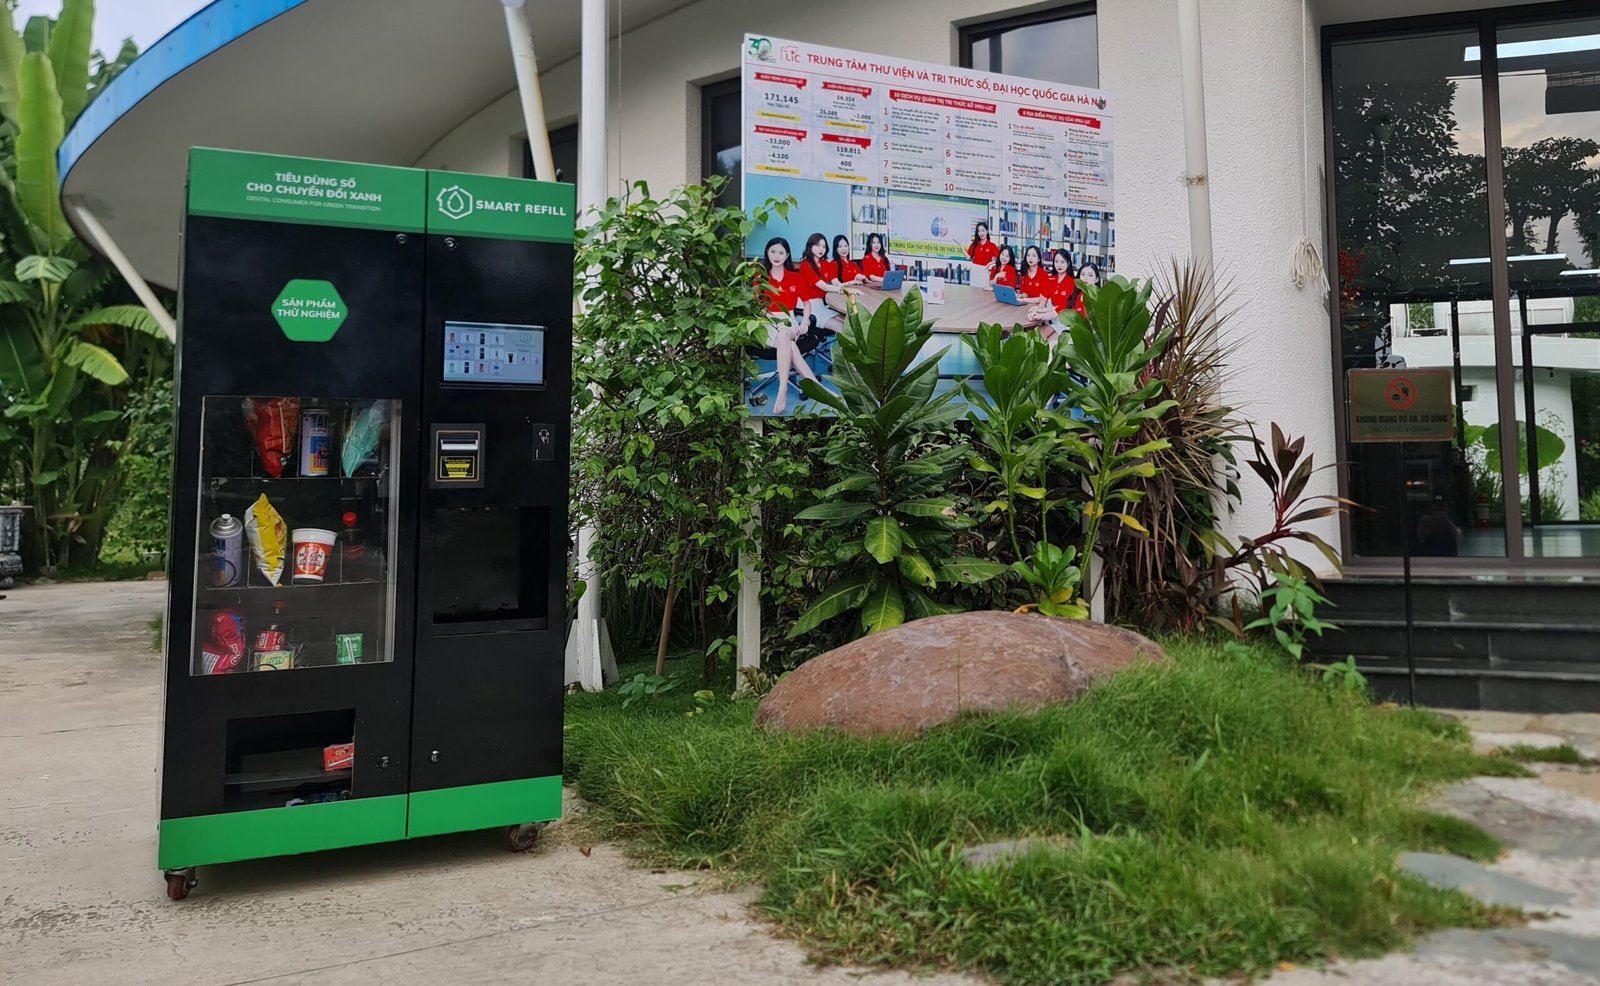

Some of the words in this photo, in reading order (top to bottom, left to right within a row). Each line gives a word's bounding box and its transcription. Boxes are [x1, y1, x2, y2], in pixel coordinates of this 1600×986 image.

[807, 54, 842, 68] TRUNG
[846, 58, 867, 72] TÂM
[869, 63, 891, 75] THƯ
[892, 66, 914, 80] VIỆN
[916, 68, 929, 81] VÀ
[931, 72, 946, 83] TRI
[948, 75, 974, 88] THỨC
[993, 82, 1009, 96] ĐẠI
[1011, 84, 1030, 98] HỌC
[1032, 88, 1059, 100] QUỐC
[1060, 93, 1075, 103] GIA
[1077, 94, 1092, 105] HÀ
[765, 93, 799, 104] 171.145
[946, 116, 951, 124] 2
[884, 124, 889, 132] 3
[946, 132, 951, 140] 4
[884, 142, 889, 150] 5
[836, 147, 861, 155] 119.811
[946, 150, 951, 158] 6
[884, 160, 889, 168] 7
[946, 167, 951, 175] 8
[275, 172, 301, 183] TIÊU
[304, 174, 337, 187] DÙNG
[340, 178, 356, 189] SỐ
[884, 176, 889, 184] 9
[247, 183, 273, 192] CHO
[276, 185, 323, 197] CHUYỂN
[350, 192, 382, 202] XANH
[246, 195, 272, 203] DIGITAL
[273, 197, 308, 206] CONSUMER
[346, 204, 381, 212] TRANSITION
[476, 200, 521, 212] SMART
[525, 204, 567, 216] REFILL
[282, 298, 304, 307] SẢN
[306, 298, 336, 308] PHẨM
[277, 308, 299, 317] THỬ
[301, 310, 340, 320] NGHIỆM
